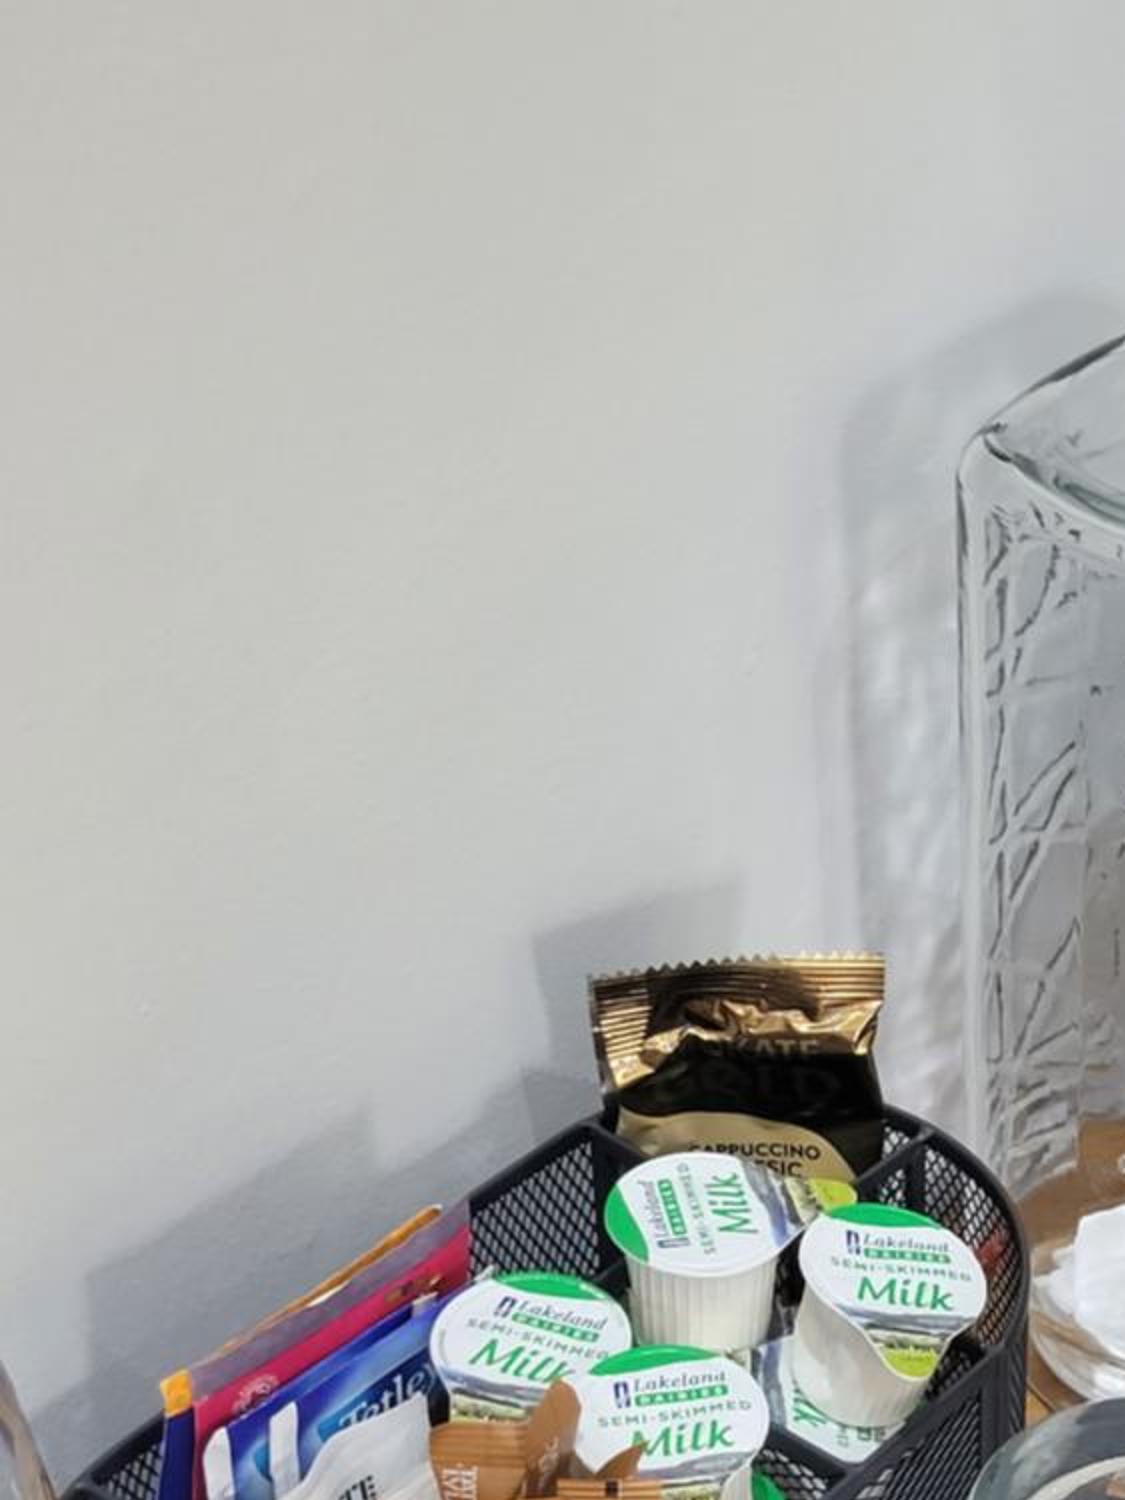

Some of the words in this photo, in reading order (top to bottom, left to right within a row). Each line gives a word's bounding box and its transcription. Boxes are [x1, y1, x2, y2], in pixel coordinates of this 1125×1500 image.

[704, 1171, 758, 1234] Milk
[863, 1233, 949, 1253] Lakeland
[831, 1256, 972, 1281] SEMI-SKIMMED
[857, 1276, 956, 1311] Milk
[519, 1301, 609, 1331] Lakeland
[467, 1317, 610, 1361] SEMI-SKIMMED
[468, 1338, 576, 1384] Milk
[634, 1371, 726, 1393] Lakeland
[597, 1400, 752, 1428] SEMI-SKIMMED
[631, 1419, 736, 1457] Milk
